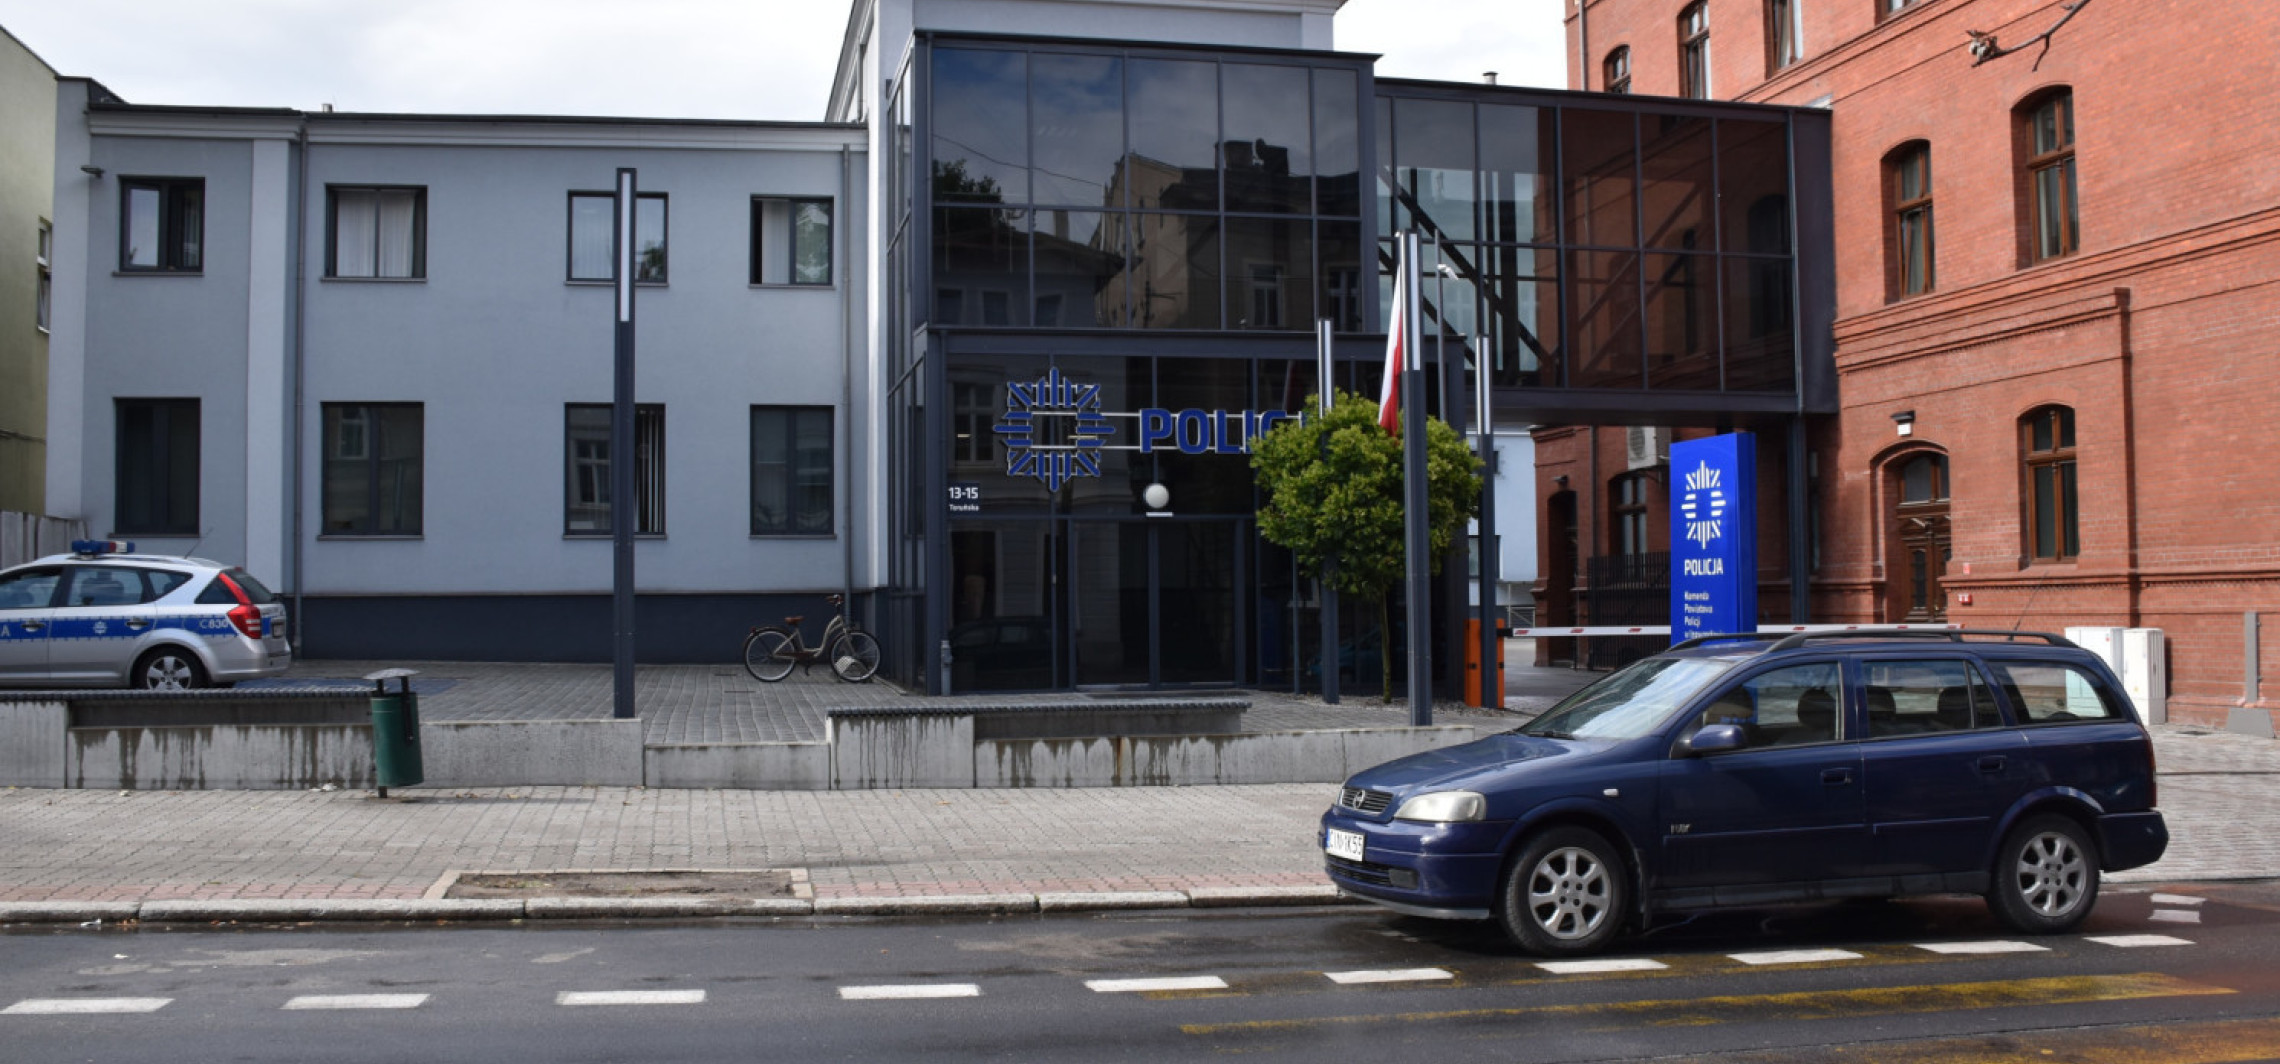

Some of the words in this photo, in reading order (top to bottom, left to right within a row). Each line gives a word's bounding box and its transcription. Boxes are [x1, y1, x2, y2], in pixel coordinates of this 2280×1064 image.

[1140, 408, 1307, 454] POLIC
[948, 487, 978, 499] 13-15
[1684, 558, 1724, 575] POLICJA
